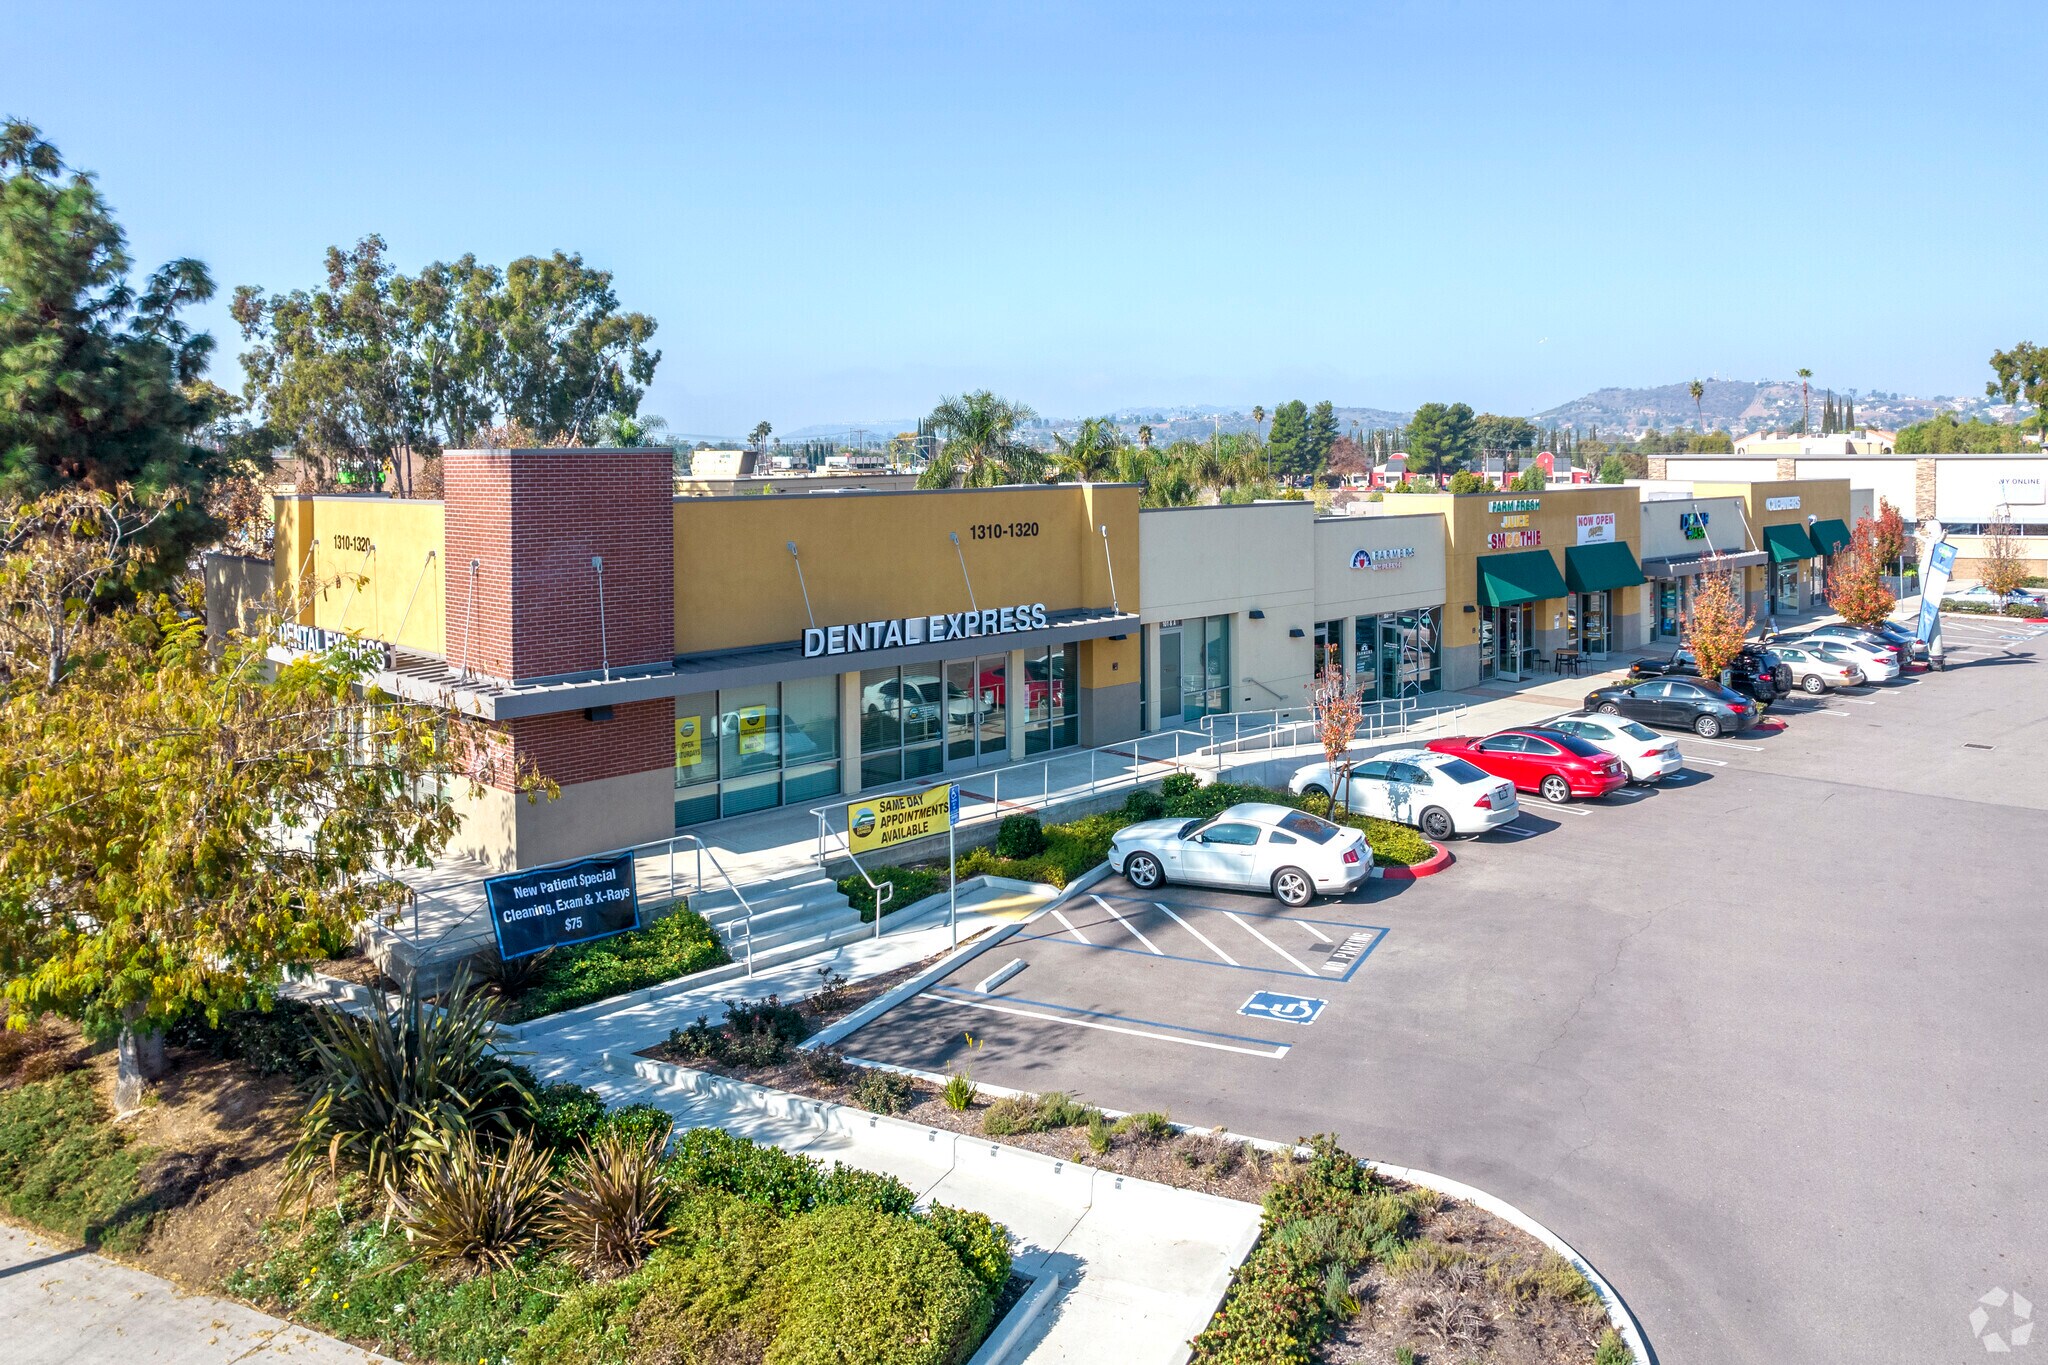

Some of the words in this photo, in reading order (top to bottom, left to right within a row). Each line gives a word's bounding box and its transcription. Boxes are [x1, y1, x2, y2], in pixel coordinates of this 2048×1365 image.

[1489, 500, 1514, 513] FARM
[1514, 499, 1540, 511] FRESH
[1501, 514, 1529, 528] JUICE
[1578, 516, 1594, 527] NOW
[1595, 515, 1614, 525] OPEN
[969, 522, 1039, 540] 1310-1320
[1488, 530, 1541, 549] SMOOTHIE
[333, 534, 371, 552] 1310-1320
[1371, 548, 1415, 560] FARMERS
[802, 617, 921, 658] DENTAL
[928, 603, 1047, 643] EXPRESS
[681, 741, 694, 749] OPEN
[879, 798, 906, 813] SAME
[908, 794, 924, 807] DAY
[880, 802, 949, 829] APPOINTMENTS
[881, 821, 929, 844] AVAILABLE
[513, 885, 538, 899] New
[539, 876, 579, 894] Patient
[579, 868, 617, 888] Special
[556, 897, 584, 912] Exam
[584, 893, 594, 906] &
[596, 887, 631, 904] X-Rays
[564, 916, 583, 932] $75
[1332, 932, 1373, 960] PARKING
[1320, 961, 1348, 973] NO
